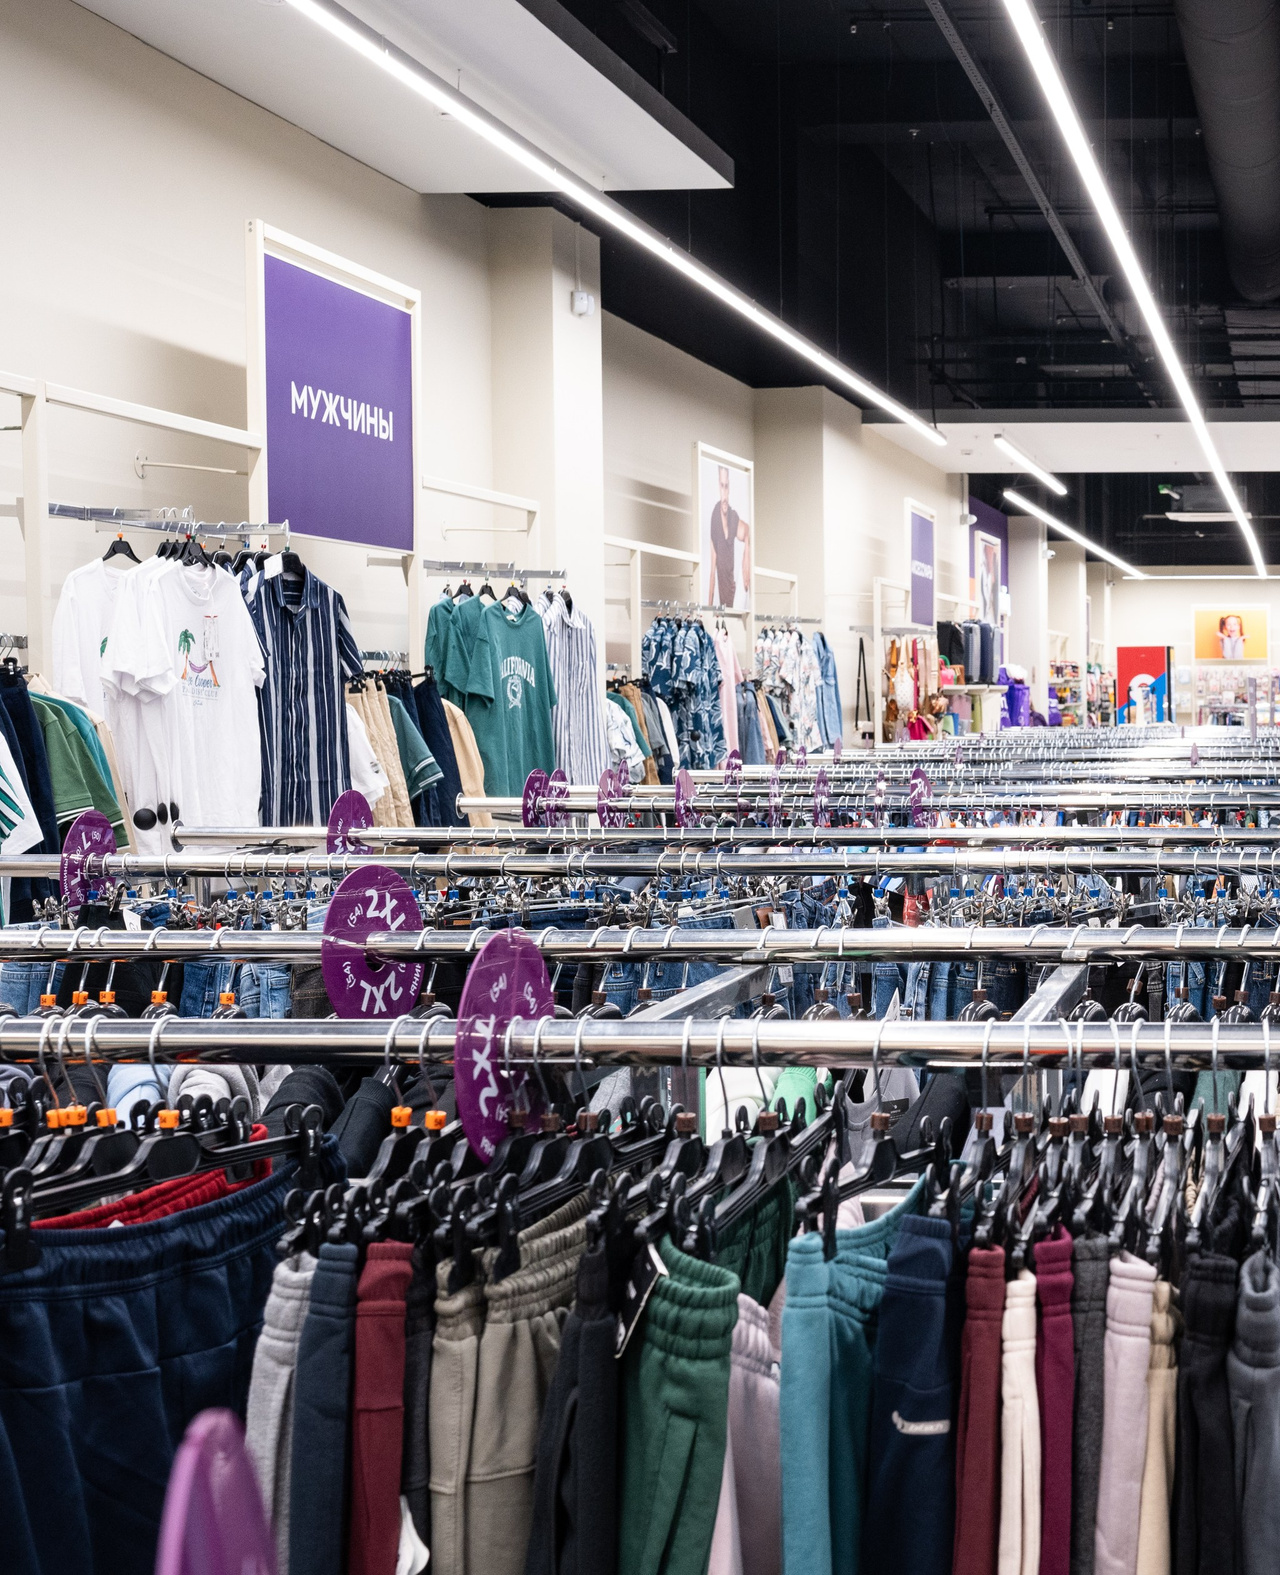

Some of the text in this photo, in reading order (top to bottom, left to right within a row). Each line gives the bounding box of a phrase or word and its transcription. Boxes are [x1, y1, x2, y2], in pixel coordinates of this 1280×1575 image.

[290, 380, 394, 441] МУЖЧИНЫ
[347, 903, 363, 928] (54)
[360, 971, 403, 1015] 2XL
[490, 973, 507, 1003] (54)
[472, 1013, 499, 1118] 2XL
